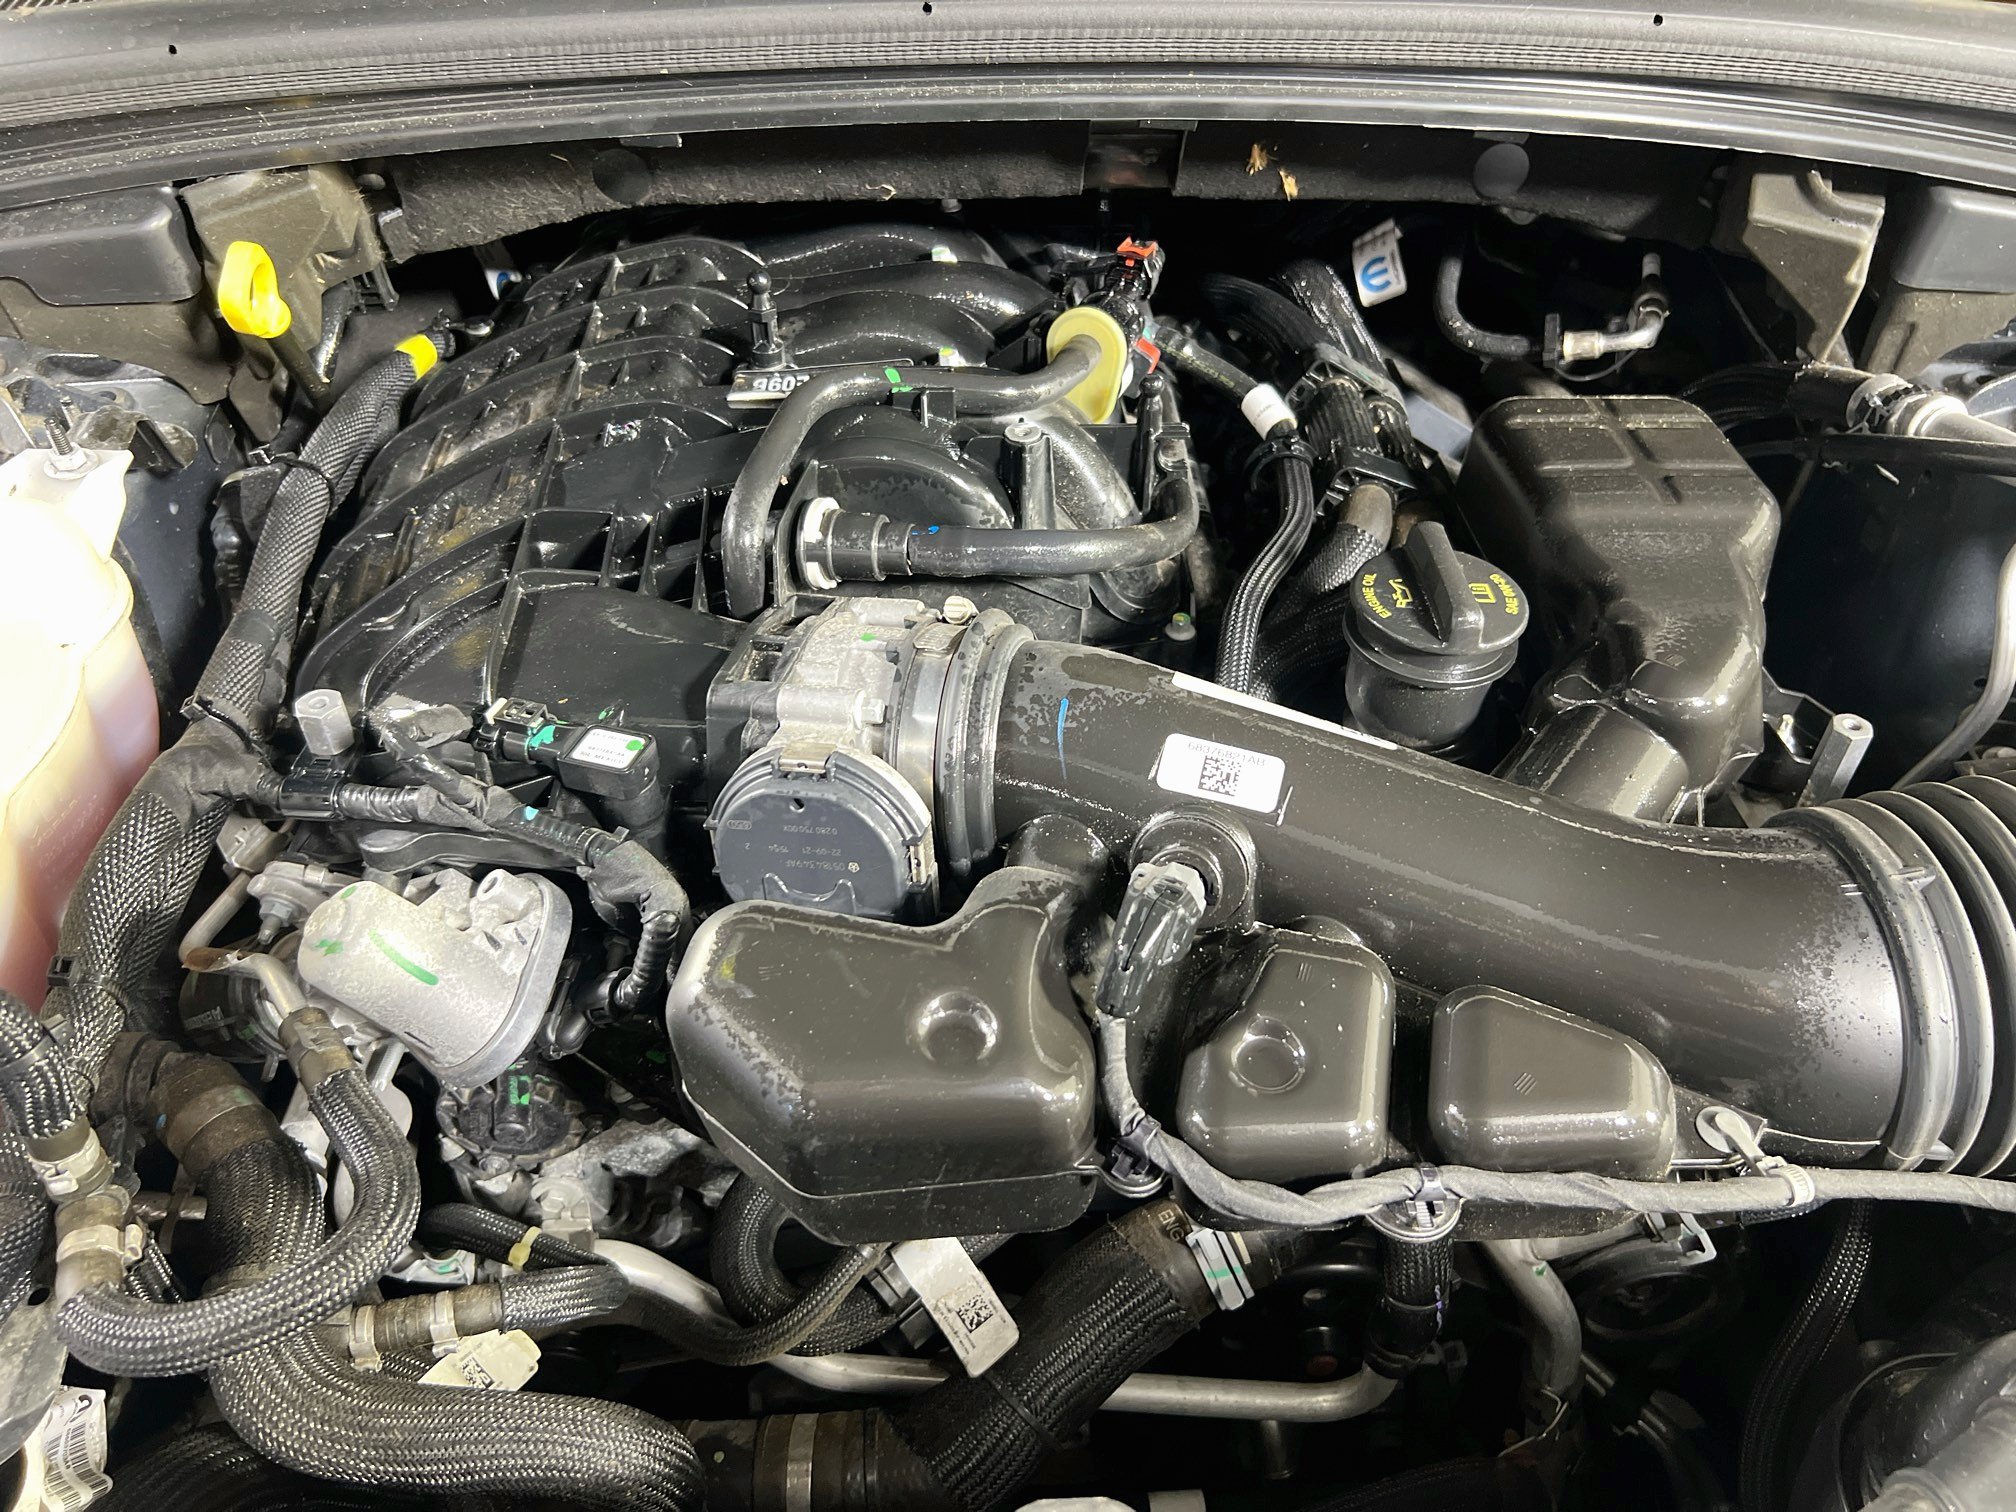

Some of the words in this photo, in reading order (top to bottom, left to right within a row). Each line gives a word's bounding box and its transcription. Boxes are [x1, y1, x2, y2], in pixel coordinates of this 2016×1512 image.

[1362, 573, 1377, 586] OIL
[1362, 587, 1392, 618] ENGINE
[1505, 598, 1519, 615] SAE
